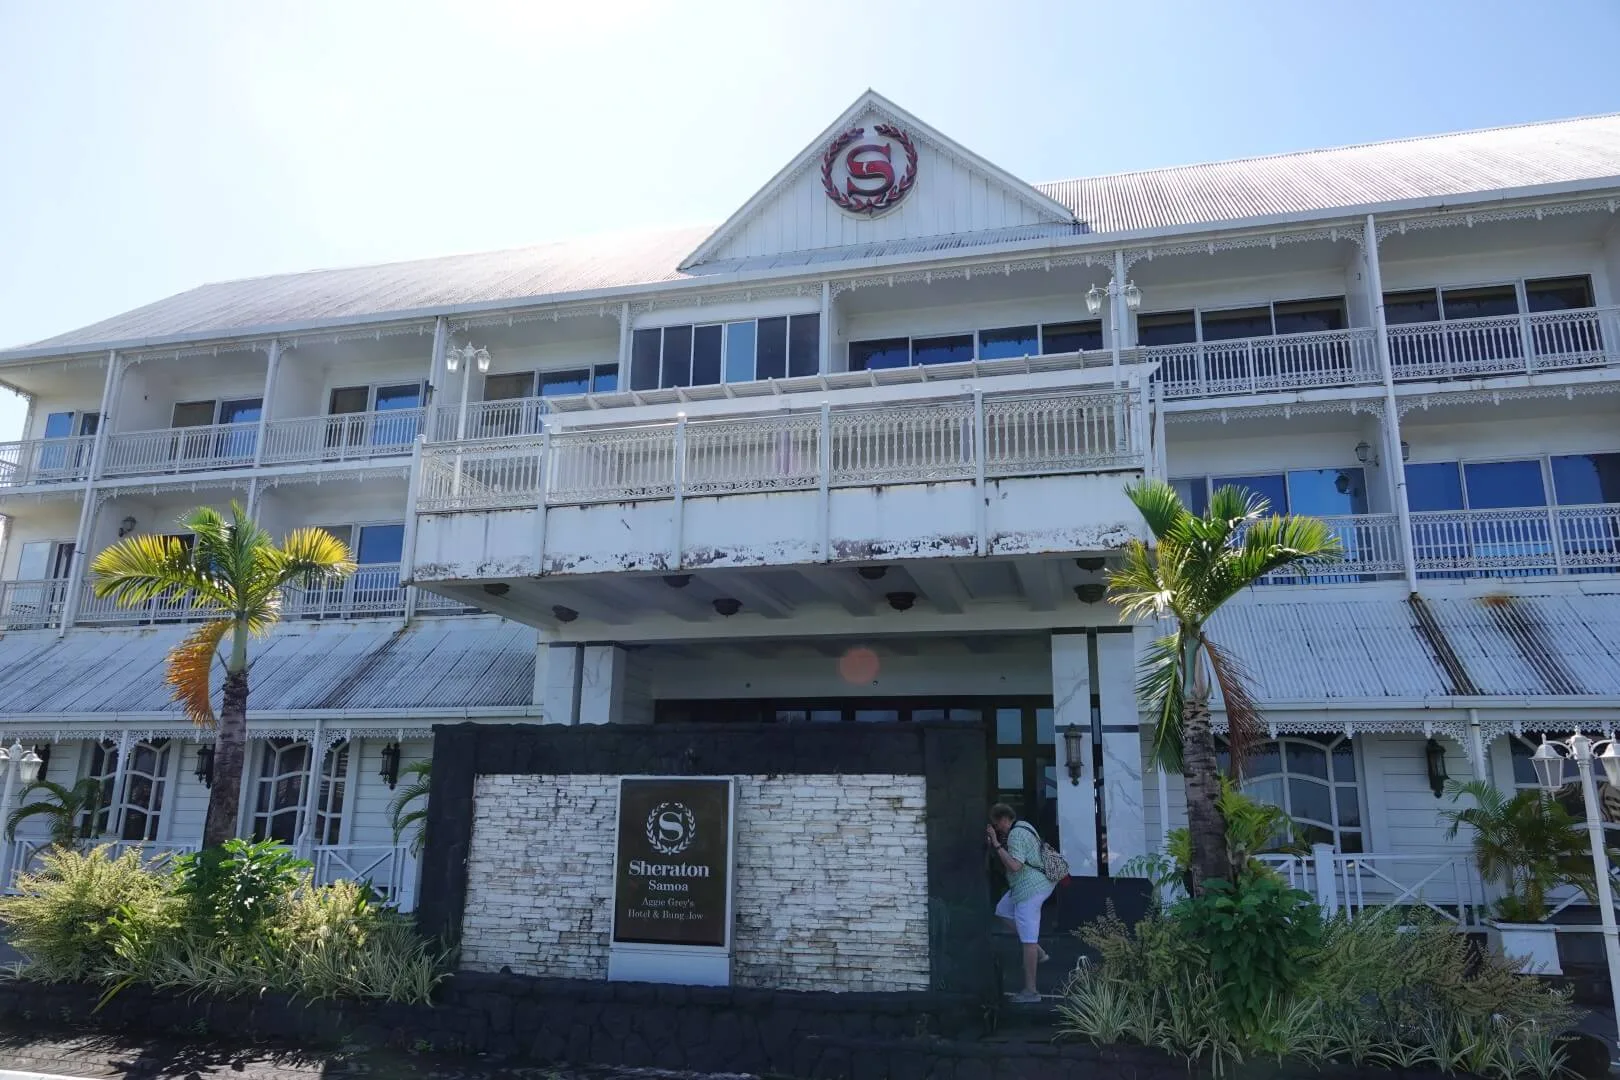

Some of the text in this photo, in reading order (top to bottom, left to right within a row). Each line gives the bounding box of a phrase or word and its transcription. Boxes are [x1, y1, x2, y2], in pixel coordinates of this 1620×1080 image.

[846, 143, 895, 197] S
[658, 811, 684, 842] S
[628, 860, 709, 877] Sheraton
[648, 880, 688, 891] Samoa
[642, 897, 694, 909] Aggie Grey's
[628, 908, 704, 920] Hotel & Bunglow
